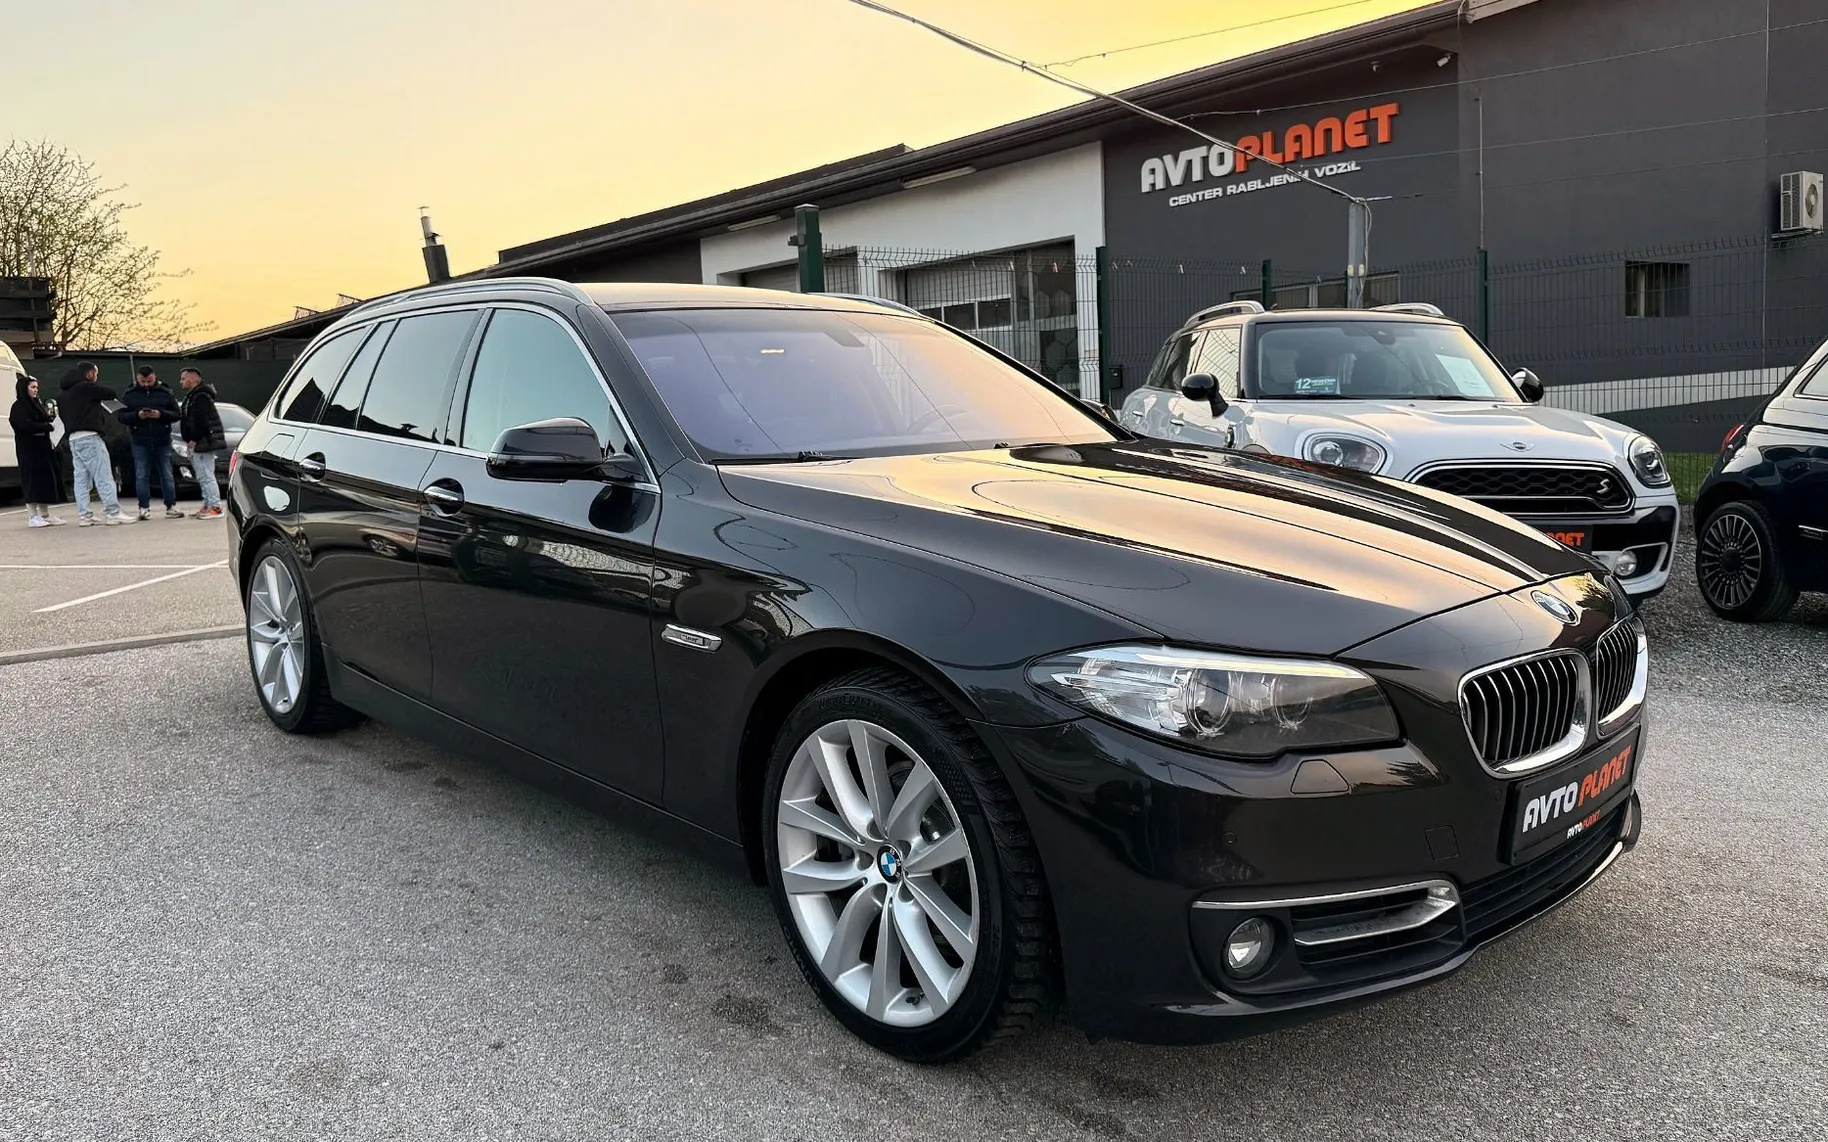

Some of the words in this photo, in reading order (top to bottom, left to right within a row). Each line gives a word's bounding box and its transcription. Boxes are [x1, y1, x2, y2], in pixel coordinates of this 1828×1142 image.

[1168, 186, 1223, 207] CENTER
[1314, 160, 1362, 178] VOZIL
[1295, 377, 1311, 390] 12
